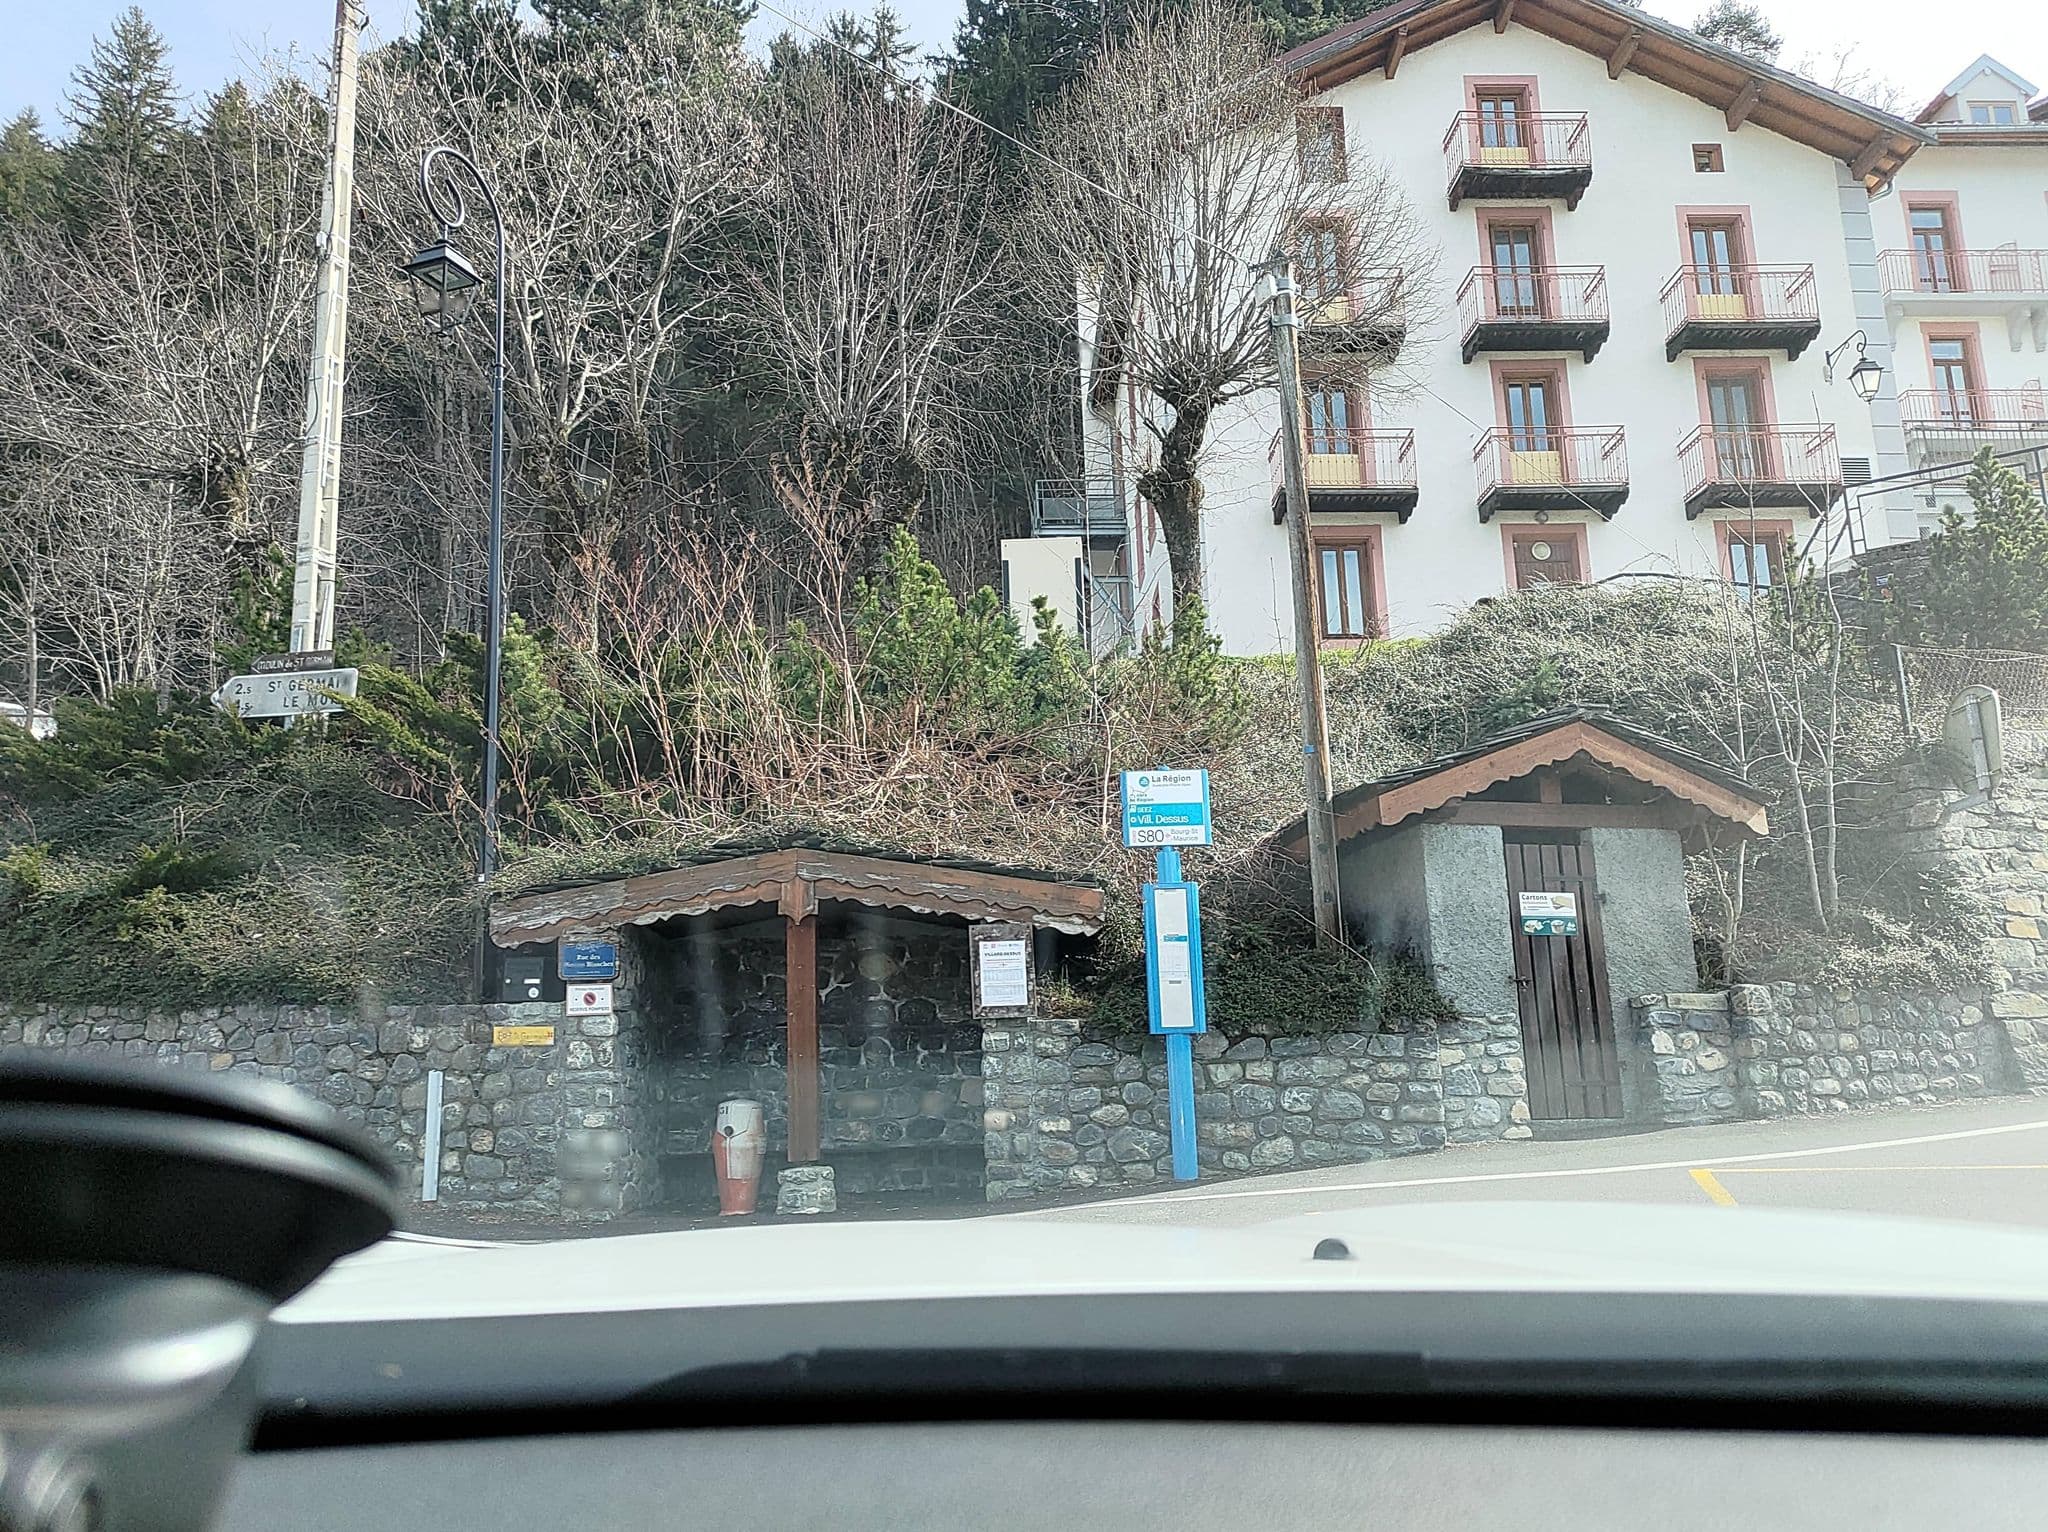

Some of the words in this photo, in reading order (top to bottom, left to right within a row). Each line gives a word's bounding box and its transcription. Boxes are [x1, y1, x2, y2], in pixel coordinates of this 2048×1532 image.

[283, 696, 299, 708] LE
[1151, 775, 1161, 783] La
[1162, 774, 1192, 784] Région
[1155, 814, 1190, 824] Dessus
[1137, 829, 1165, 843] S80
